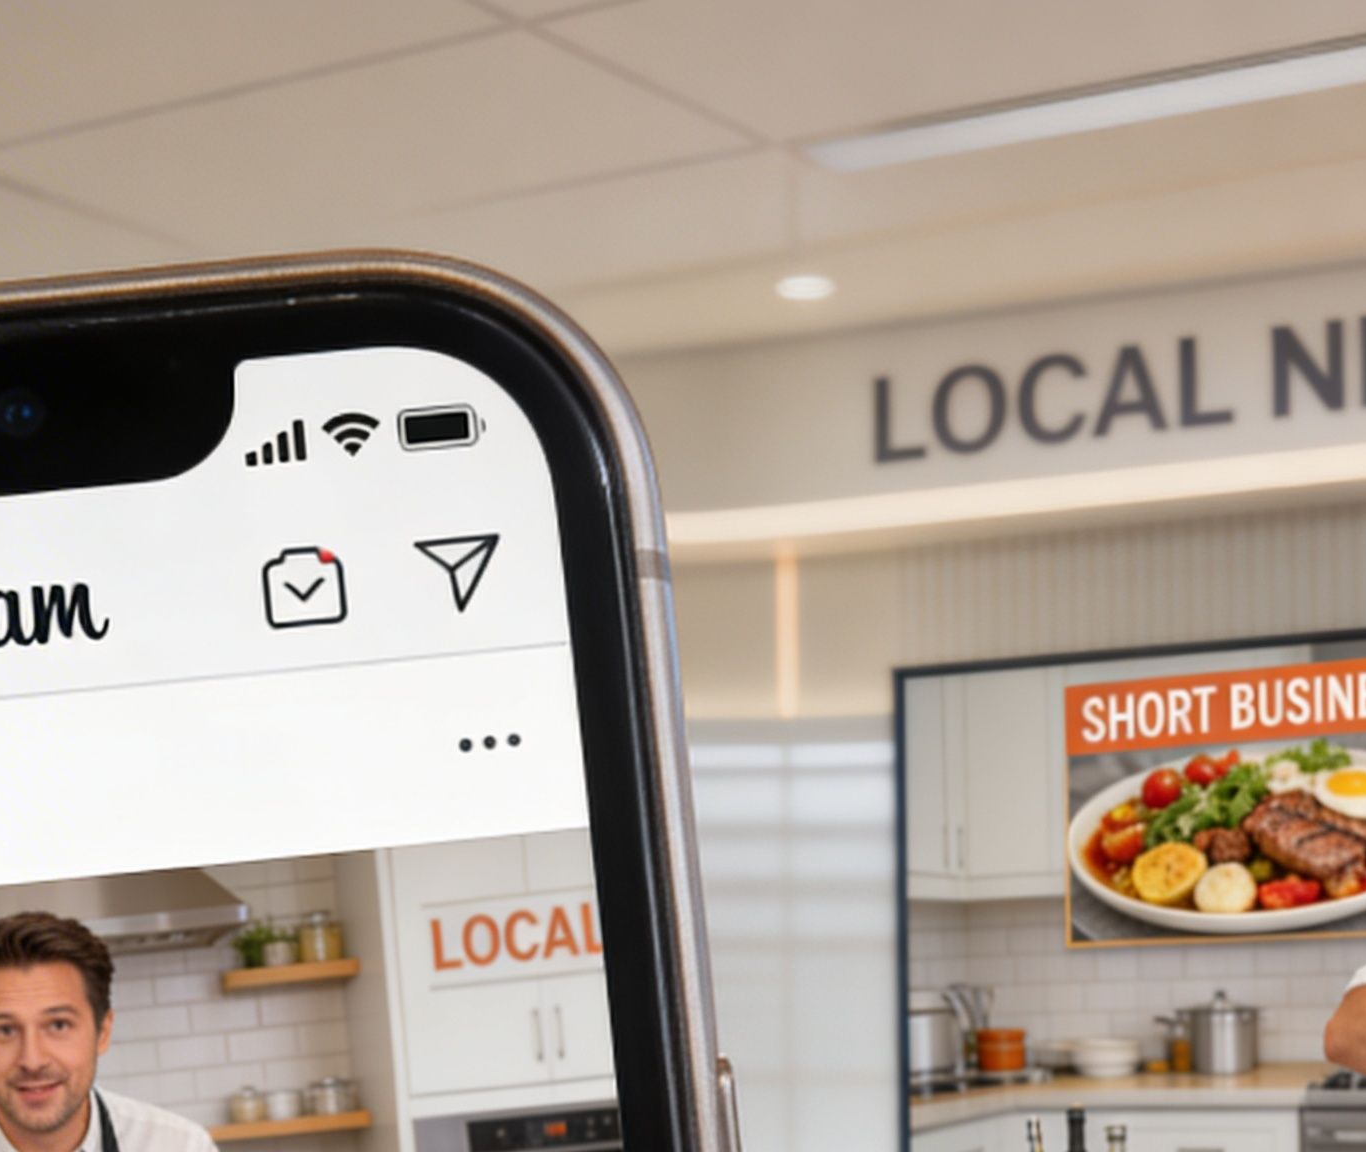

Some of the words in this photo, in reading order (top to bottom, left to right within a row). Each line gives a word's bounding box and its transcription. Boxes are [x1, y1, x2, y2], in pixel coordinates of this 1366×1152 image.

[871, 335, 1235, 466] LOCAL
[1081, 685, 1218, 744] SHORT
[430, 902, 604, 971] LOCAL
